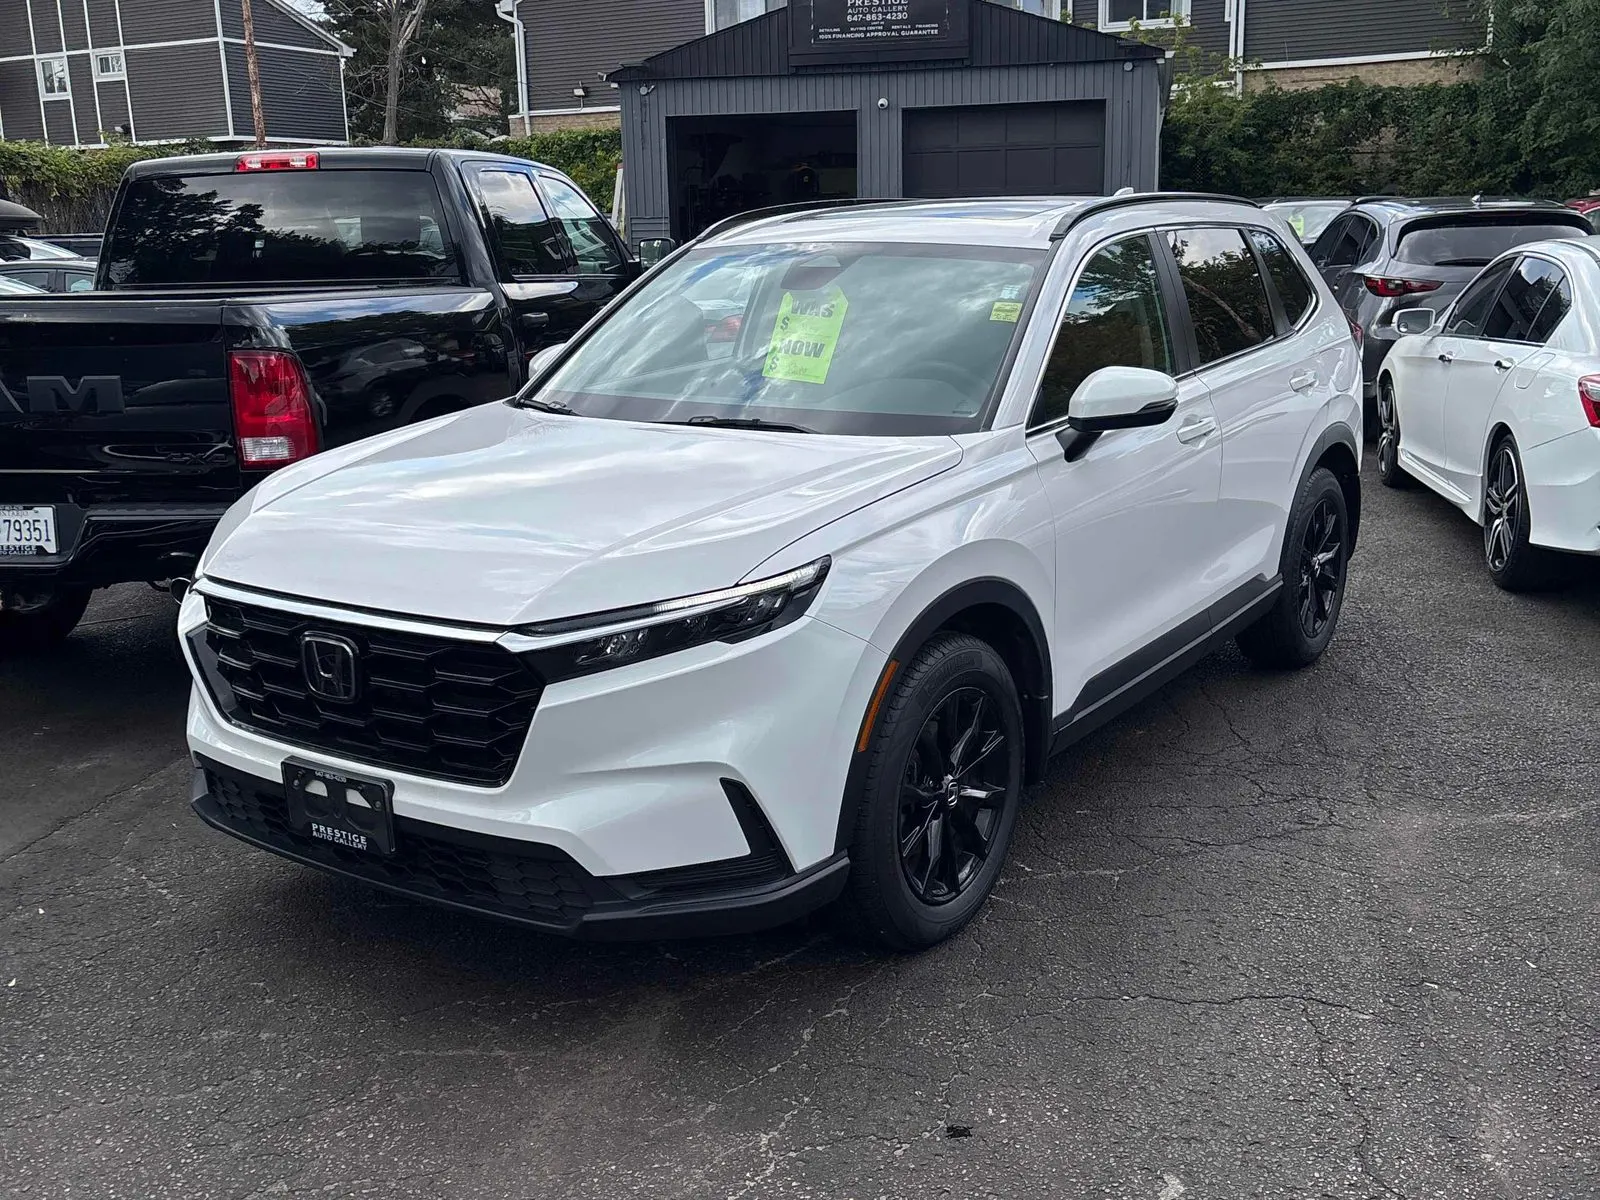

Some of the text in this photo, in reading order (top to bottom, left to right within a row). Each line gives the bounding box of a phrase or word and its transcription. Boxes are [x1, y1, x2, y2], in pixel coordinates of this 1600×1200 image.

[847, 13, 908, 22] 647-863-4230
[871, 5, 908, 13] GALLERY
[791, 299, 835, 318] WAS
[780, 316, 790, 331] $
[779, 339, 825, 358] NOW
[769, 356, 779, 371] $
[312, 823, 367, 844] PRESTIGE
[312, 830, 367, 850] AUTO GALLERY
